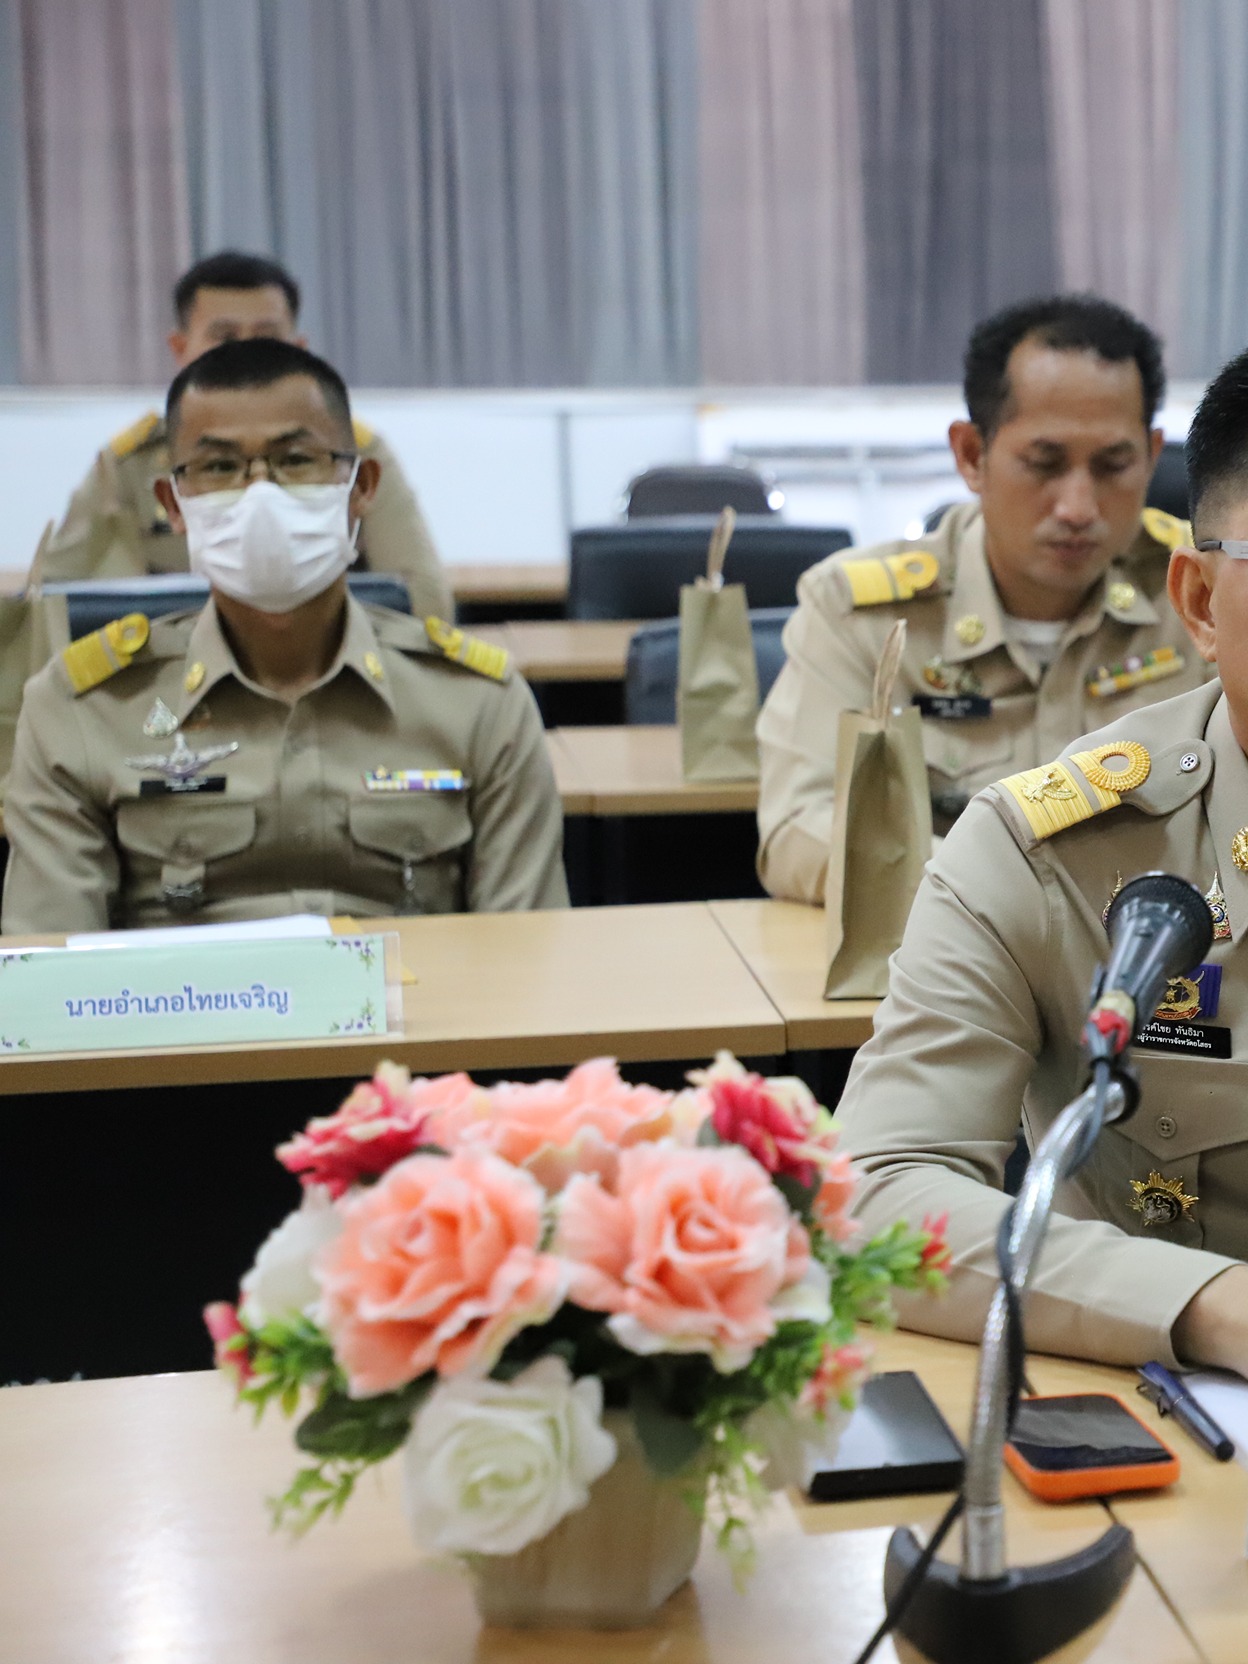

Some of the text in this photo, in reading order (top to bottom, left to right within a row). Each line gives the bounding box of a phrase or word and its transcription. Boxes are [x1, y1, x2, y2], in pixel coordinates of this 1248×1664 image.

[65, 983, 289, 1017] นายอำเภอไทยเจริญ
[1174, 1025, 1204, 1037] ทันธิมา
